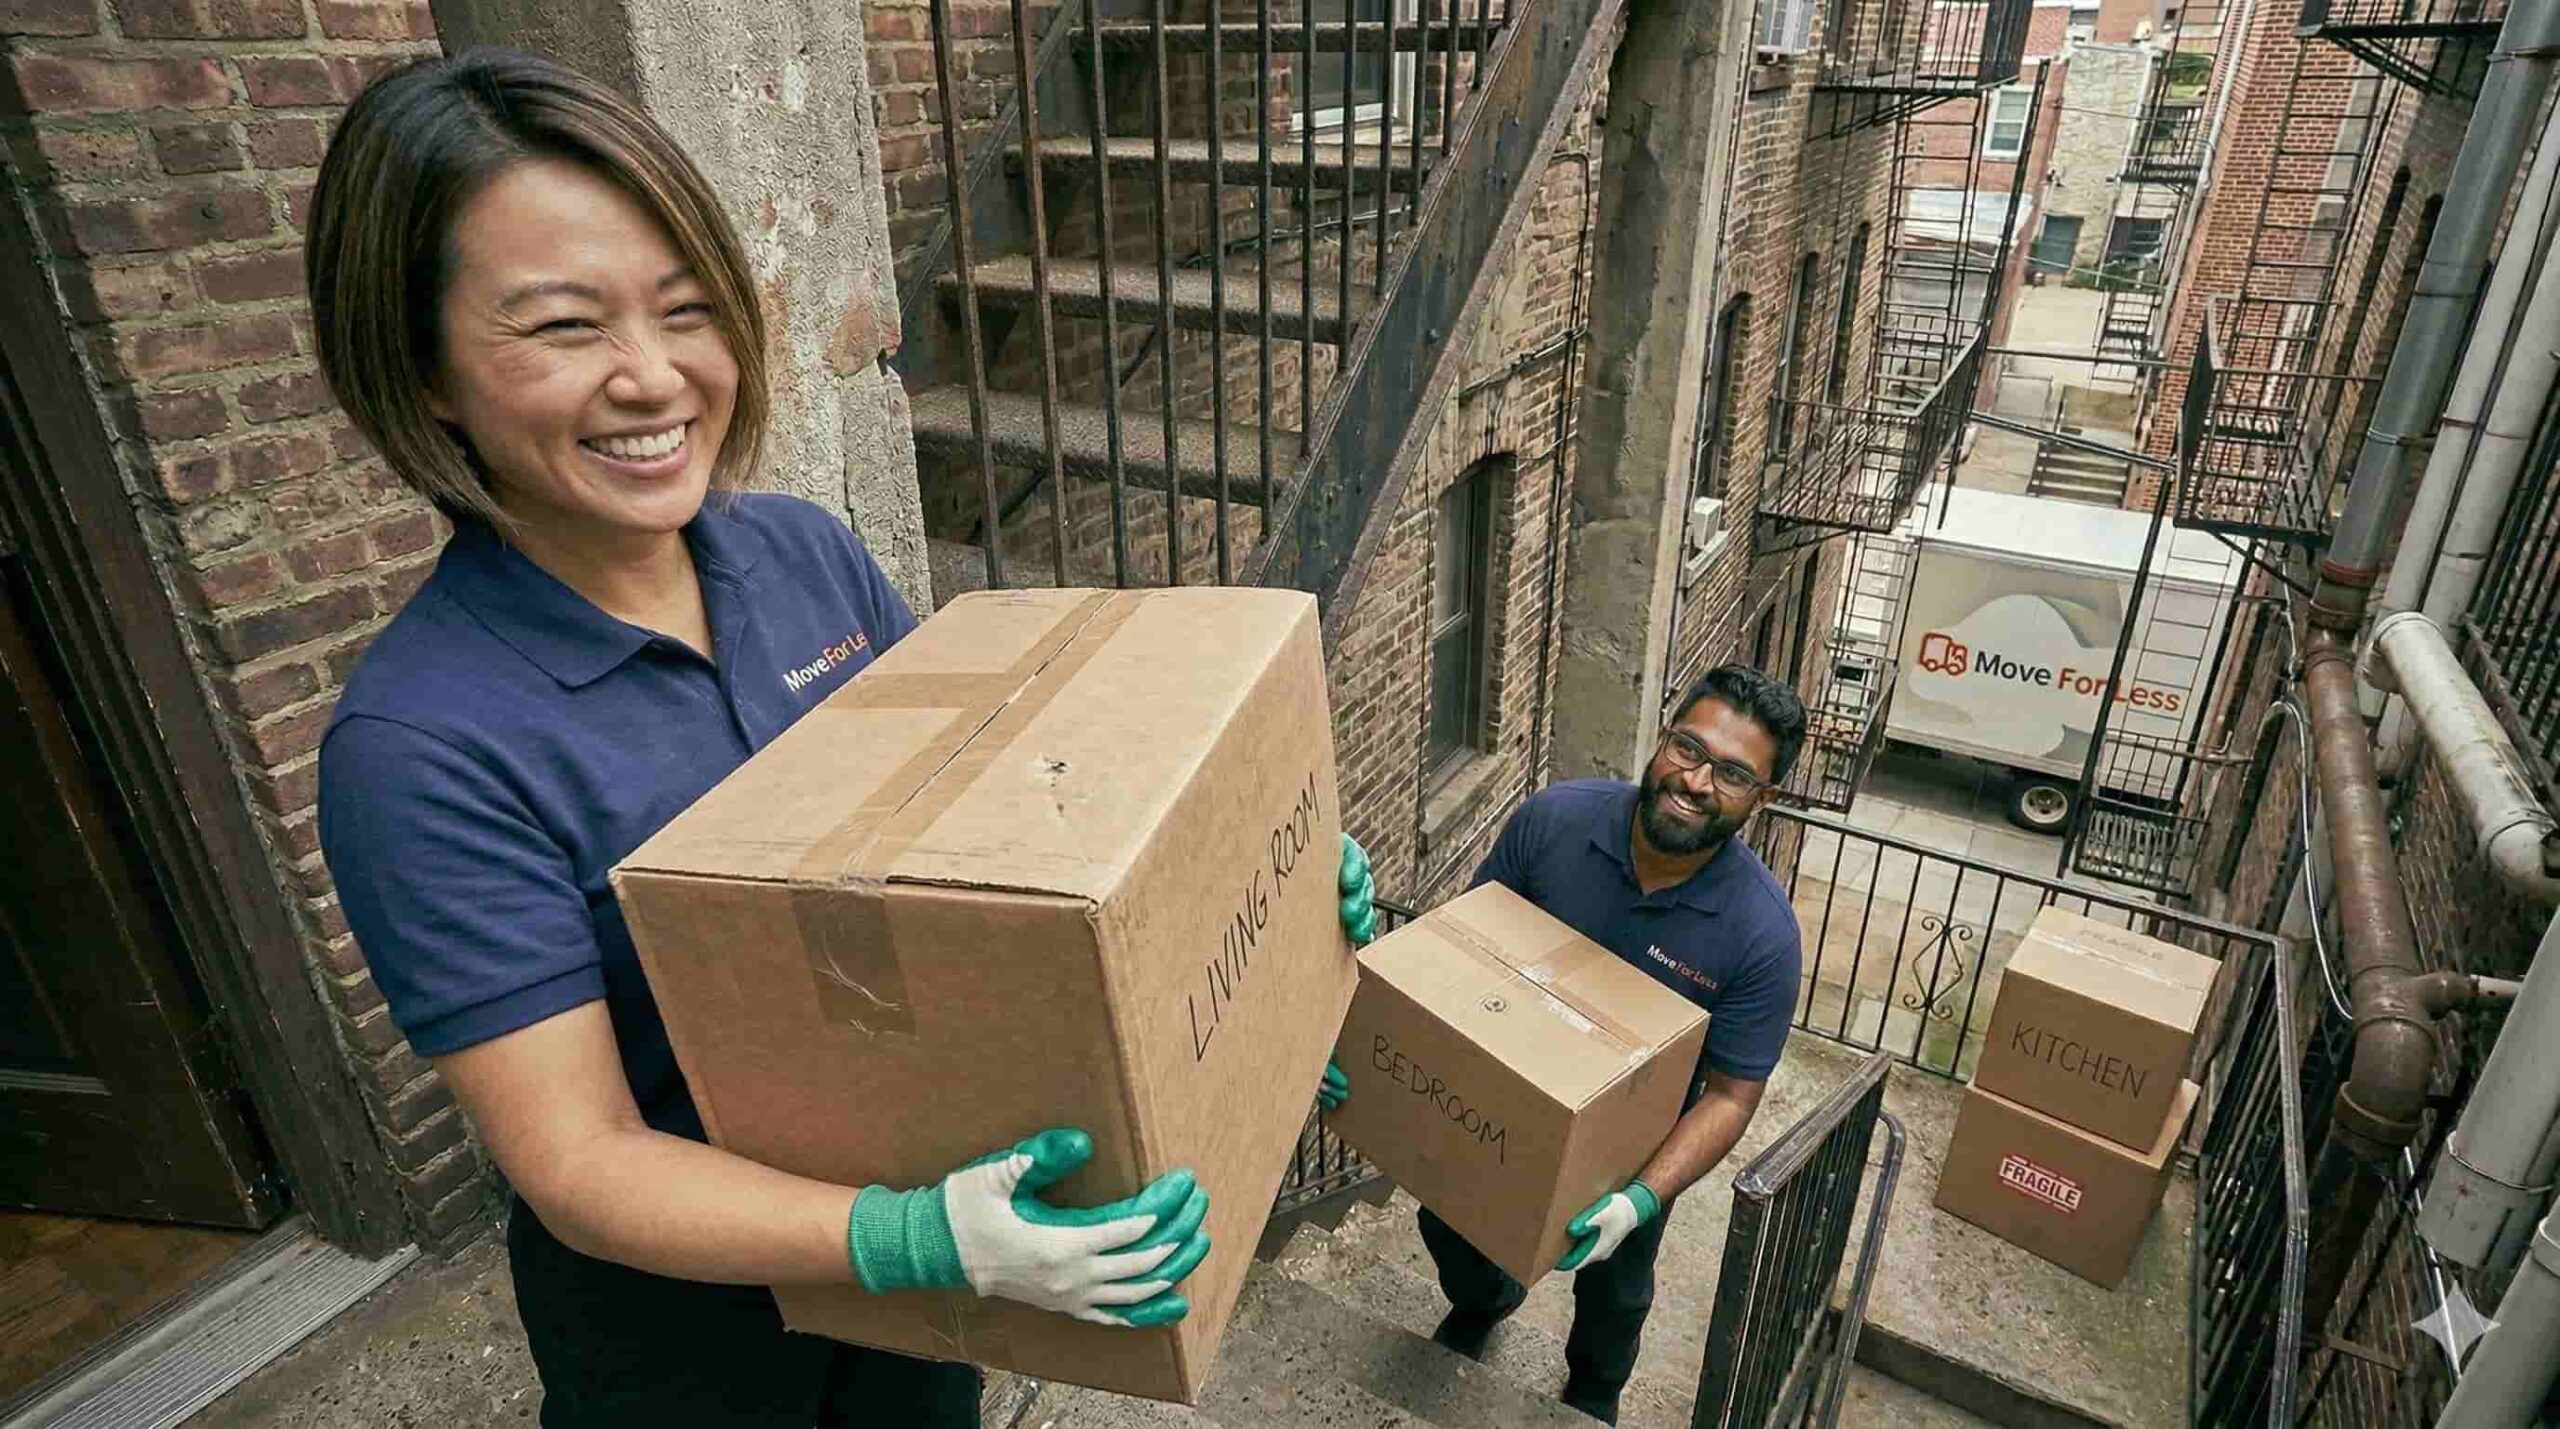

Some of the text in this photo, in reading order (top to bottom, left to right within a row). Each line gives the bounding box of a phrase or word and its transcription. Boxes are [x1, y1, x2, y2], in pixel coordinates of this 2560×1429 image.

[1974, 651, 2180, 712] Move For Less
[1189, 771, 1320, 1062] LIVING ROOM
[1646, 944, 1677, 969] Move
[2011, 1021, 2148, 1099] KITCHEN
[1371, 1034, 1506, 1166] BEDROOM
[2003, 1161, 2078, 1207] FRAGILE
